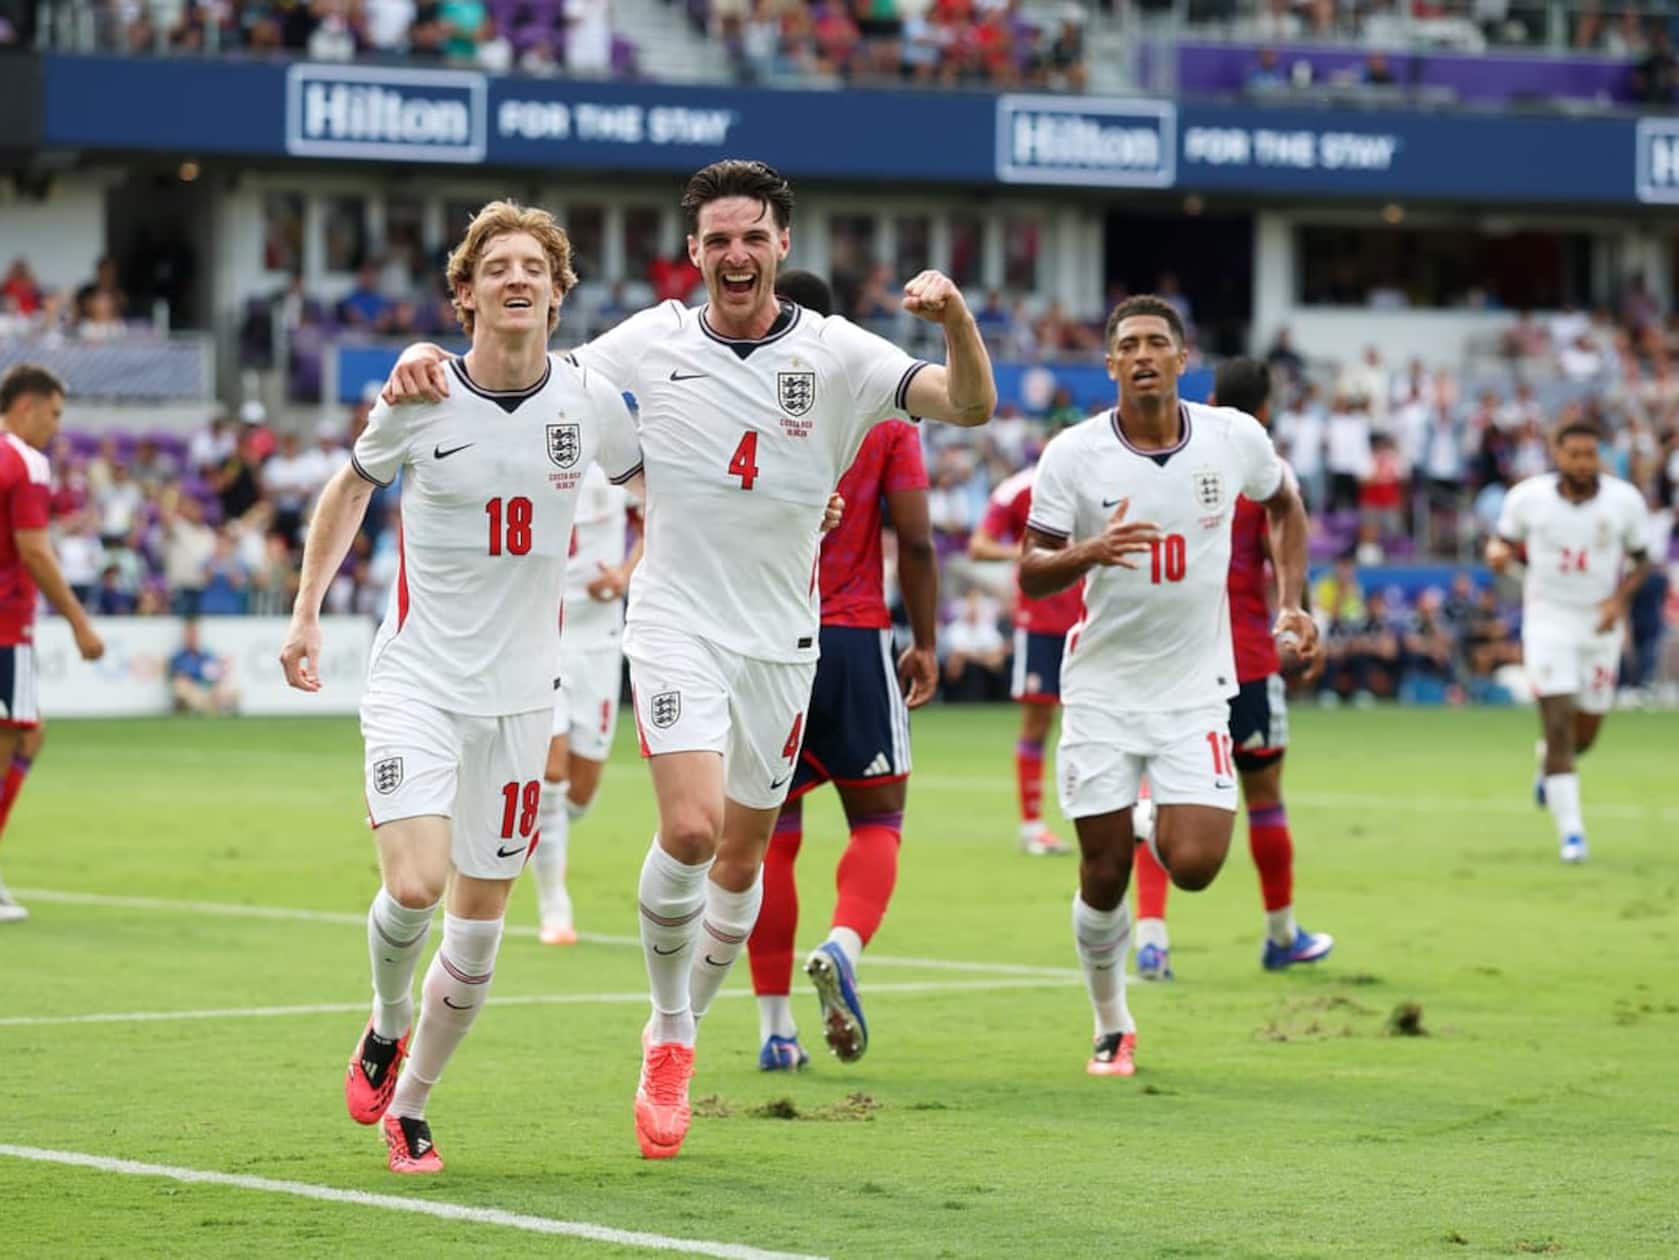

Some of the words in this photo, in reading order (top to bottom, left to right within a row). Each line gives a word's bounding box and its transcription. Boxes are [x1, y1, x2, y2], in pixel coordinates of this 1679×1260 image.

[305, 82, 468, 144] Hilton
[499, 100, 570, 139] FOR
[575, 103, 643, 143] THE
[649, 106, 732, 146] STAY
[1014, 112, 1160, 167] Hilton
[1184, 126, 1249, 165] FOR
[1254, 129, 1316, 168] THE
[1320, 132, 1396, 171] STAY
[727, 431, 759, 490] 4
[485, 496, 533, 556] 18
[1149, 534, 1186, 584] 10
[782, 712, 803, 767] 4
[501, 780, 541, 839] 18
